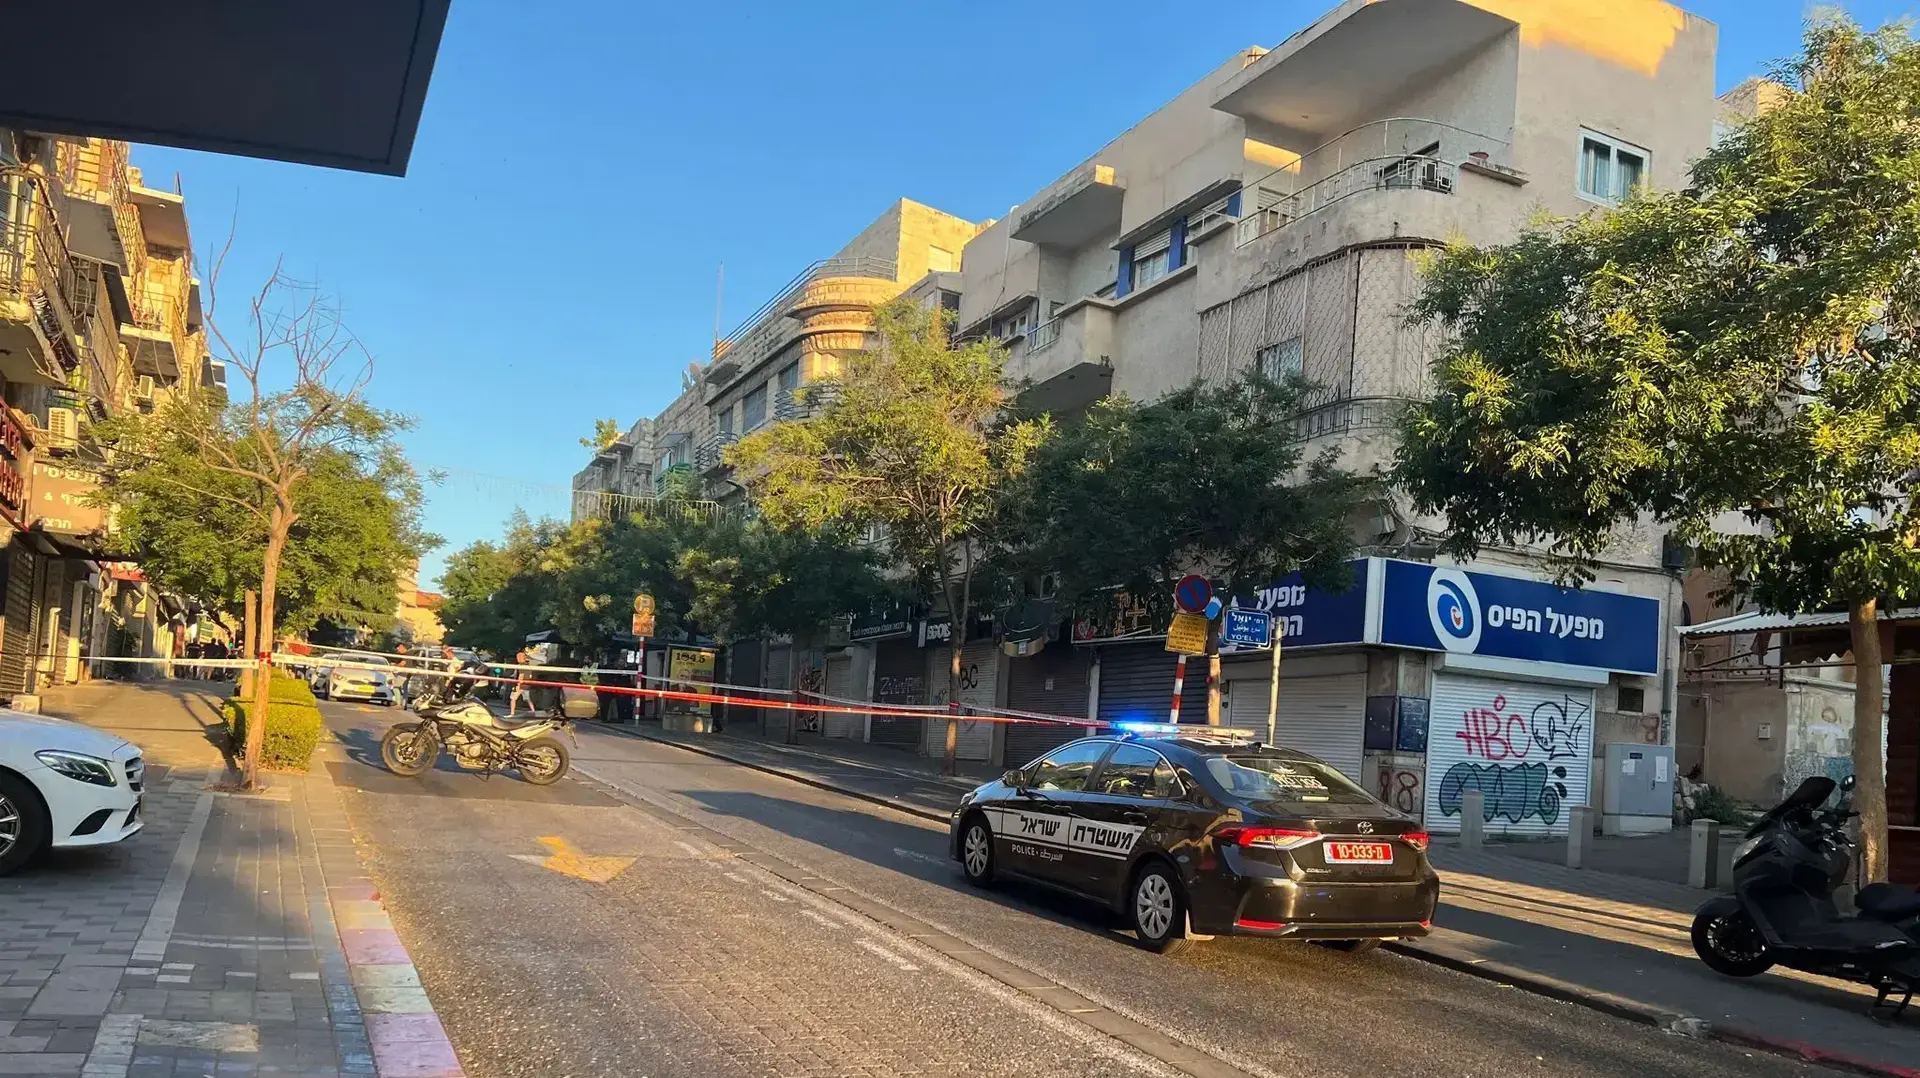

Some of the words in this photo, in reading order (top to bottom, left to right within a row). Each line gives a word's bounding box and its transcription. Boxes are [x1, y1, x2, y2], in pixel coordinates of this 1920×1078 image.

[1231, 611, 1252, 623] יואל
[1488, 604, 1542, 633] הפיס
[1545, 607, 1604, 640] מפעל
[1231, 633, 1254, 642] YO'EL
[958, 663, 979, 691] BC
[1455, 707, 1532, 761] HBC
[1020, 814, 1061, 837] ישראל
[1073, 824, 1134, 850] משטרת
[1011, 843, 1035, 857] POLICE
